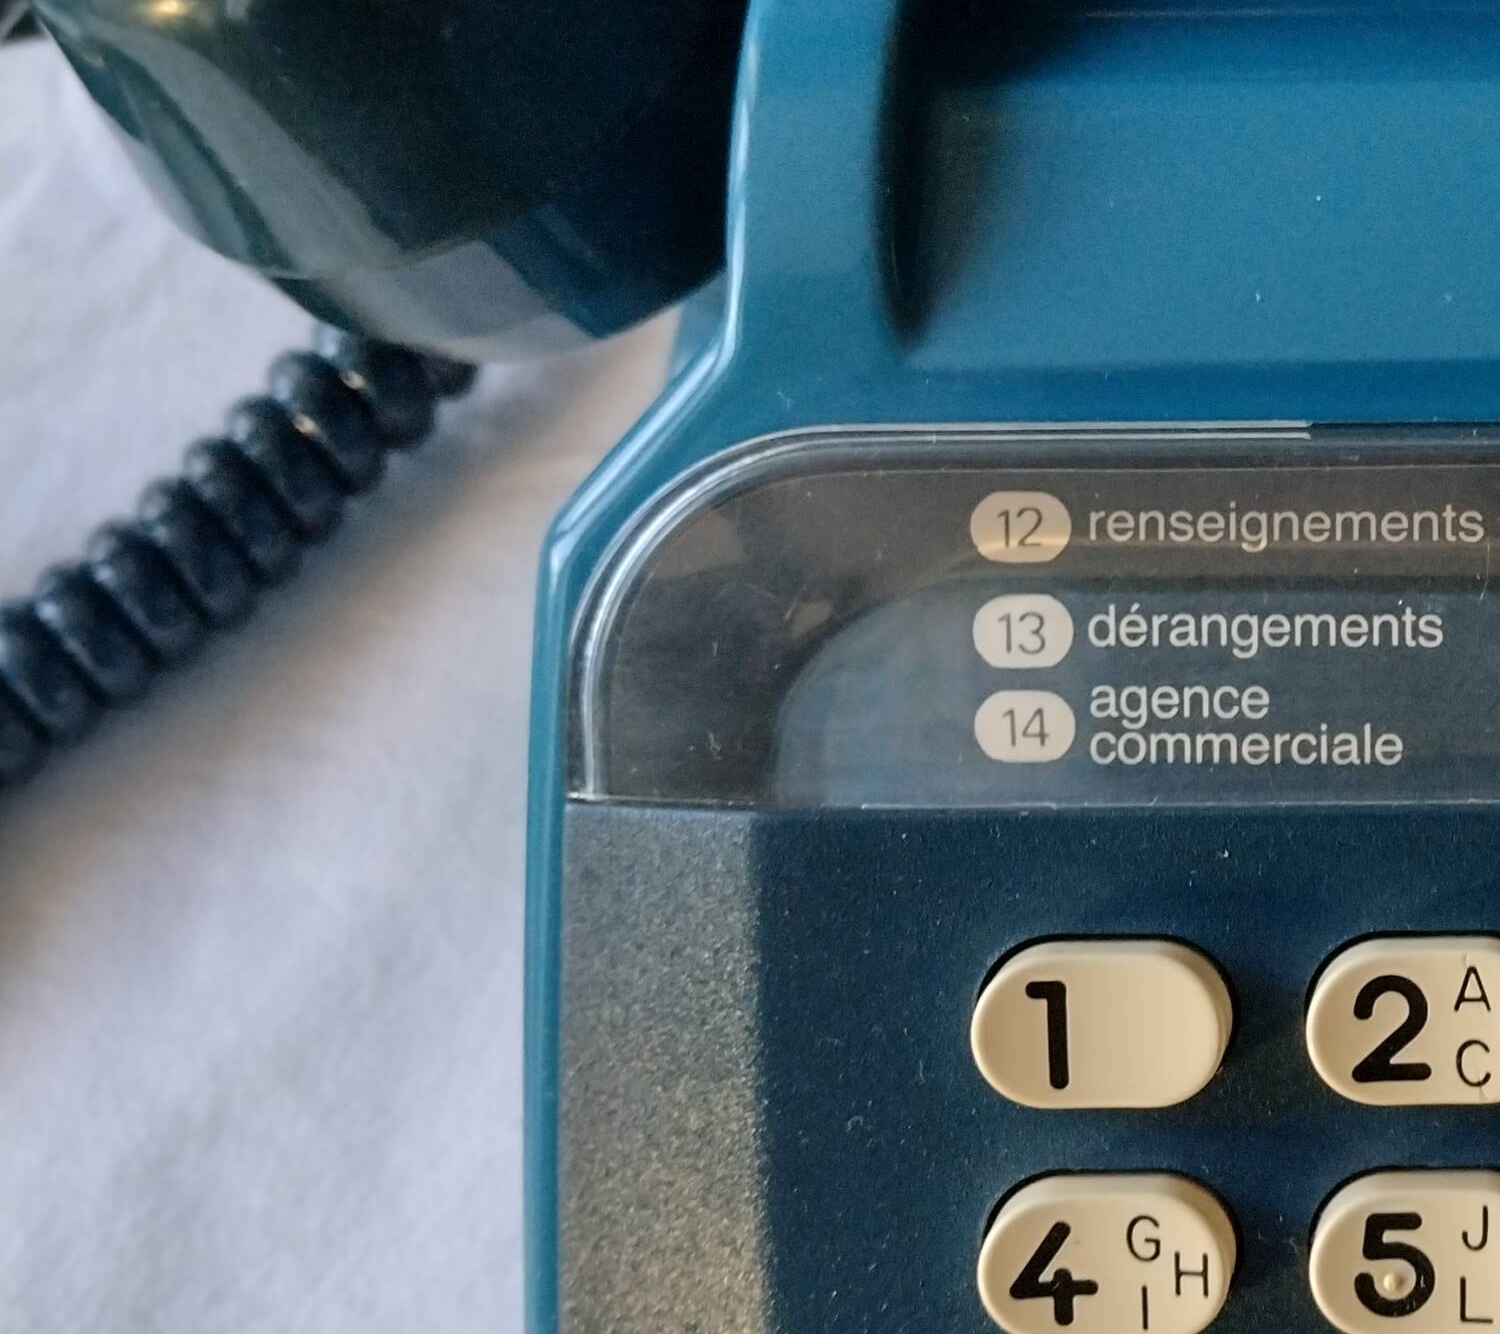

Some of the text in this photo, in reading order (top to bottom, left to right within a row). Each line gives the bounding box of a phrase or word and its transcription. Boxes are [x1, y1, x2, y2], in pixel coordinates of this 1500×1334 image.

[997, 501, 1485, 553] 12 renseignements
[998, 602, 1444, 659] 13 dérangements
[1002, 707, 1404, 766] 14 commerciale
[1090, 685, 1270, 725] agence
[1025, 980, 1070, 1090] 1
[1351, 974, 1432, 1084] 2
[1008, 1221, 1099, 1327] 4
[1353, 1212, 1436, 1318] 5
